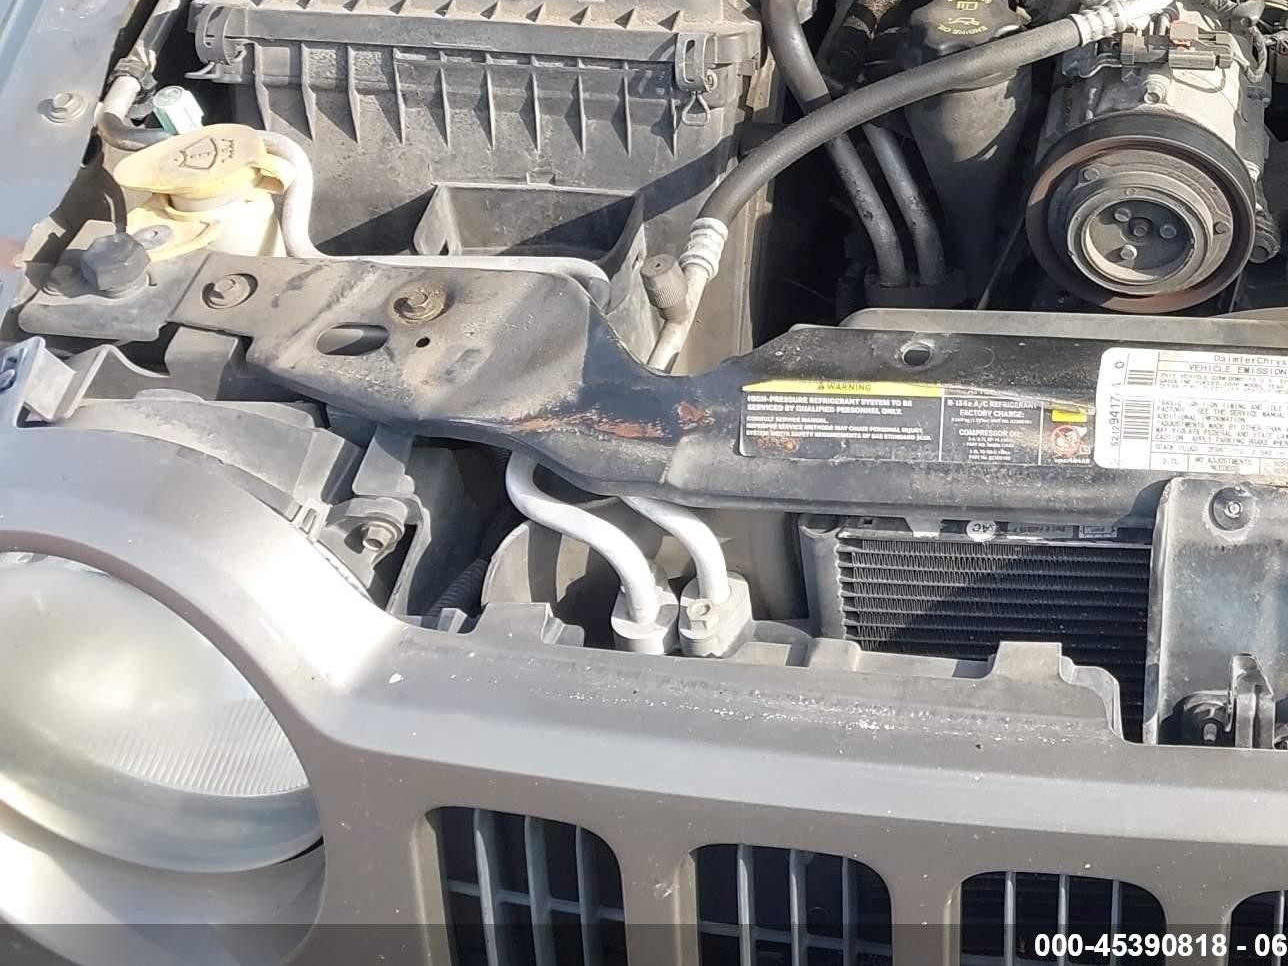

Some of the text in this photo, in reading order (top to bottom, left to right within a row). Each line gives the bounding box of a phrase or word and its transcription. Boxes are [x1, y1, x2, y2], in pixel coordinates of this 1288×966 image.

[952, 25, 989, 35] ENGINE
[1188, 363, 1231, 373] VEHICLE
[1237, 365, 1287, 376] EMISSION
[827, 382, 872, 392] WARNING
[747, 394, 809, 404] HIGH-PRESSURE
[809, 396, 861, 405] REFRIGERANT
[860, 398, 891, 406] SYSTEM
[973, 399, 989, 408] A/C
[989, 401, 1037, 409] REFRIGERANT
[747, 403, 784, 412] SERVICED
[784, 404, 795, 412] BY
[796, 405, 835, 413] QUALIFIED
[836, 406, 881, 415] PERSONNEL
[959, 409, 992, 417] FACTORY
[958, 428, 1008, 437] COMPRESSOR
